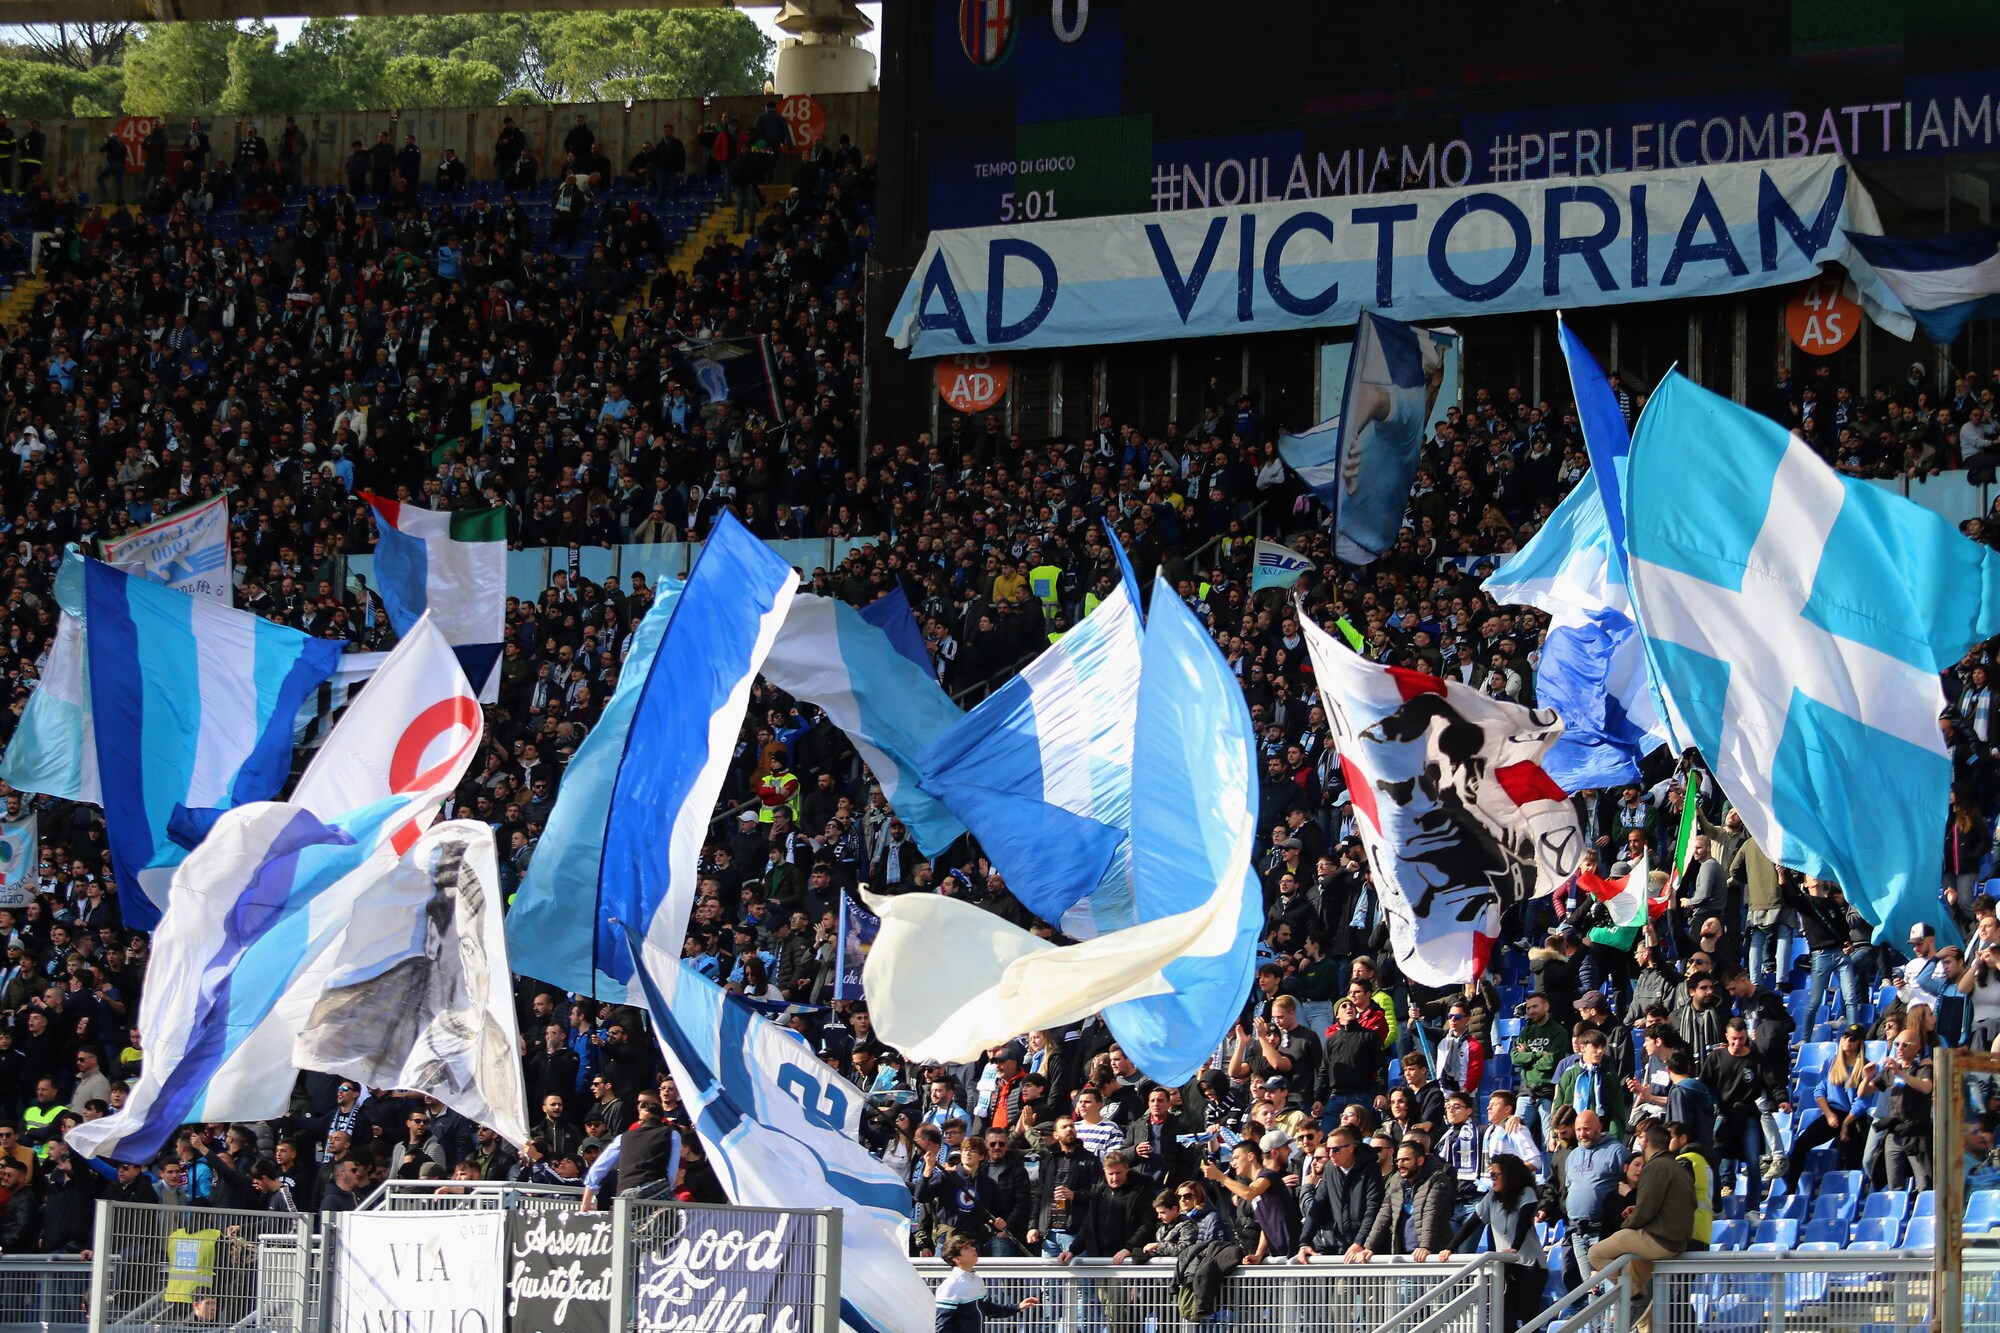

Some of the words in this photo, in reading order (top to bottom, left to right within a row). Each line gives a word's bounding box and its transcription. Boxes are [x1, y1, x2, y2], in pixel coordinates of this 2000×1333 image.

[782, 98, 811, 121] 48
[122, 120, 152, 142] 49
[974, 160, 1017, 178] TEMPO
[1020, 159, 1033, 174] DI
[1036, 156, 1075, 173] GIOCO
[1150, 139, 1473, 212] #NOILAMIAMO
[1489, 94, 2000, 183] #PERLEICOMBATTIAM
[1000, 190, 1057, 222] 5:01
[918, 238, 1059, 345] AD
[1803, 280, 1840, 311] 47
[1801, 313, 1842, 346] AS
[949, 373, 994, 402] AD
[842, 970, 858, 984] che
[513, 1217, 613, 1257] Assenti
[389, 1243, 450, 1282] VIA
